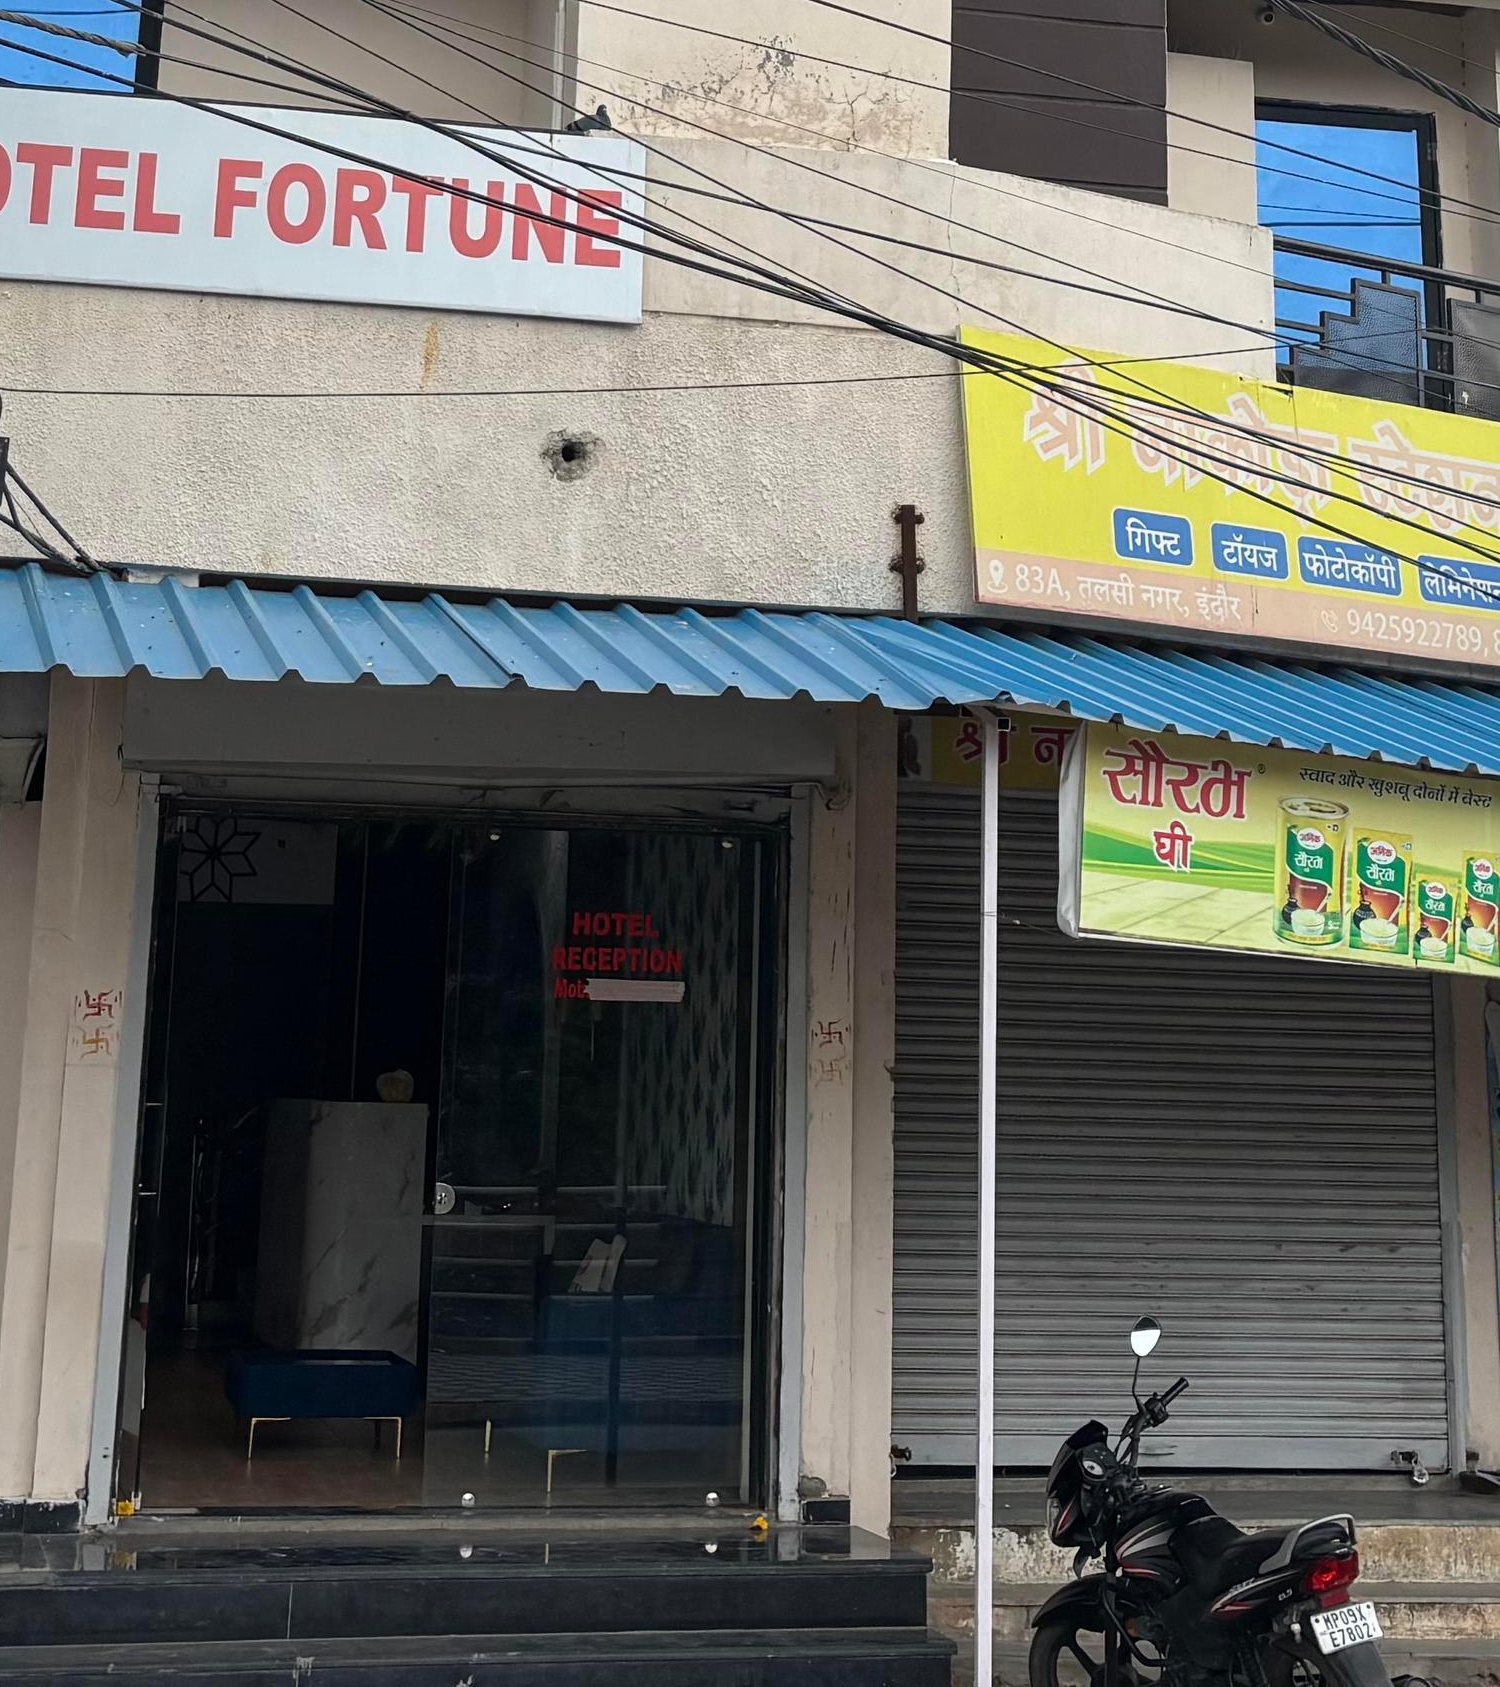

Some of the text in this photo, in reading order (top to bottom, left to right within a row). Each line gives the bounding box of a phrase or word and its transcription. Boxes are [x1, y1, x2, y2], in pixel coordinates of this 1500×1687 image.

[213, 158, 622, 268] FORTUNE
[1023, 358, 1107, 475] श्री
[1126, 517, 1181, 557] गिफ्ट
[1220, 534, 1278, 572] टॉयज
[1302, 544, 1396, 590] फोटोकॉपी
[1015, 563, 1071, 602] 83A,
[1140, 584, 1190, 617] नगर,
[1195, 584, 1242, 622] इंदौर
[1347, 608, 1489, 657] 9425922789,
[1103, 739, 1252, 819] सौरभ
[1300, 768, 1336, 785] स्वाद
[1338, 769, 1365, 789] और
[1413, 782, 1445, 802] दोनों
[1448, 786, 1461, 804] में
[1154, 820, 1193, 872] घी
[573, 911, 660, 938] HOTEL
[552, 946, 684, 974] RECEPTION
[1329, 1622, 1374, 1649] E7802
